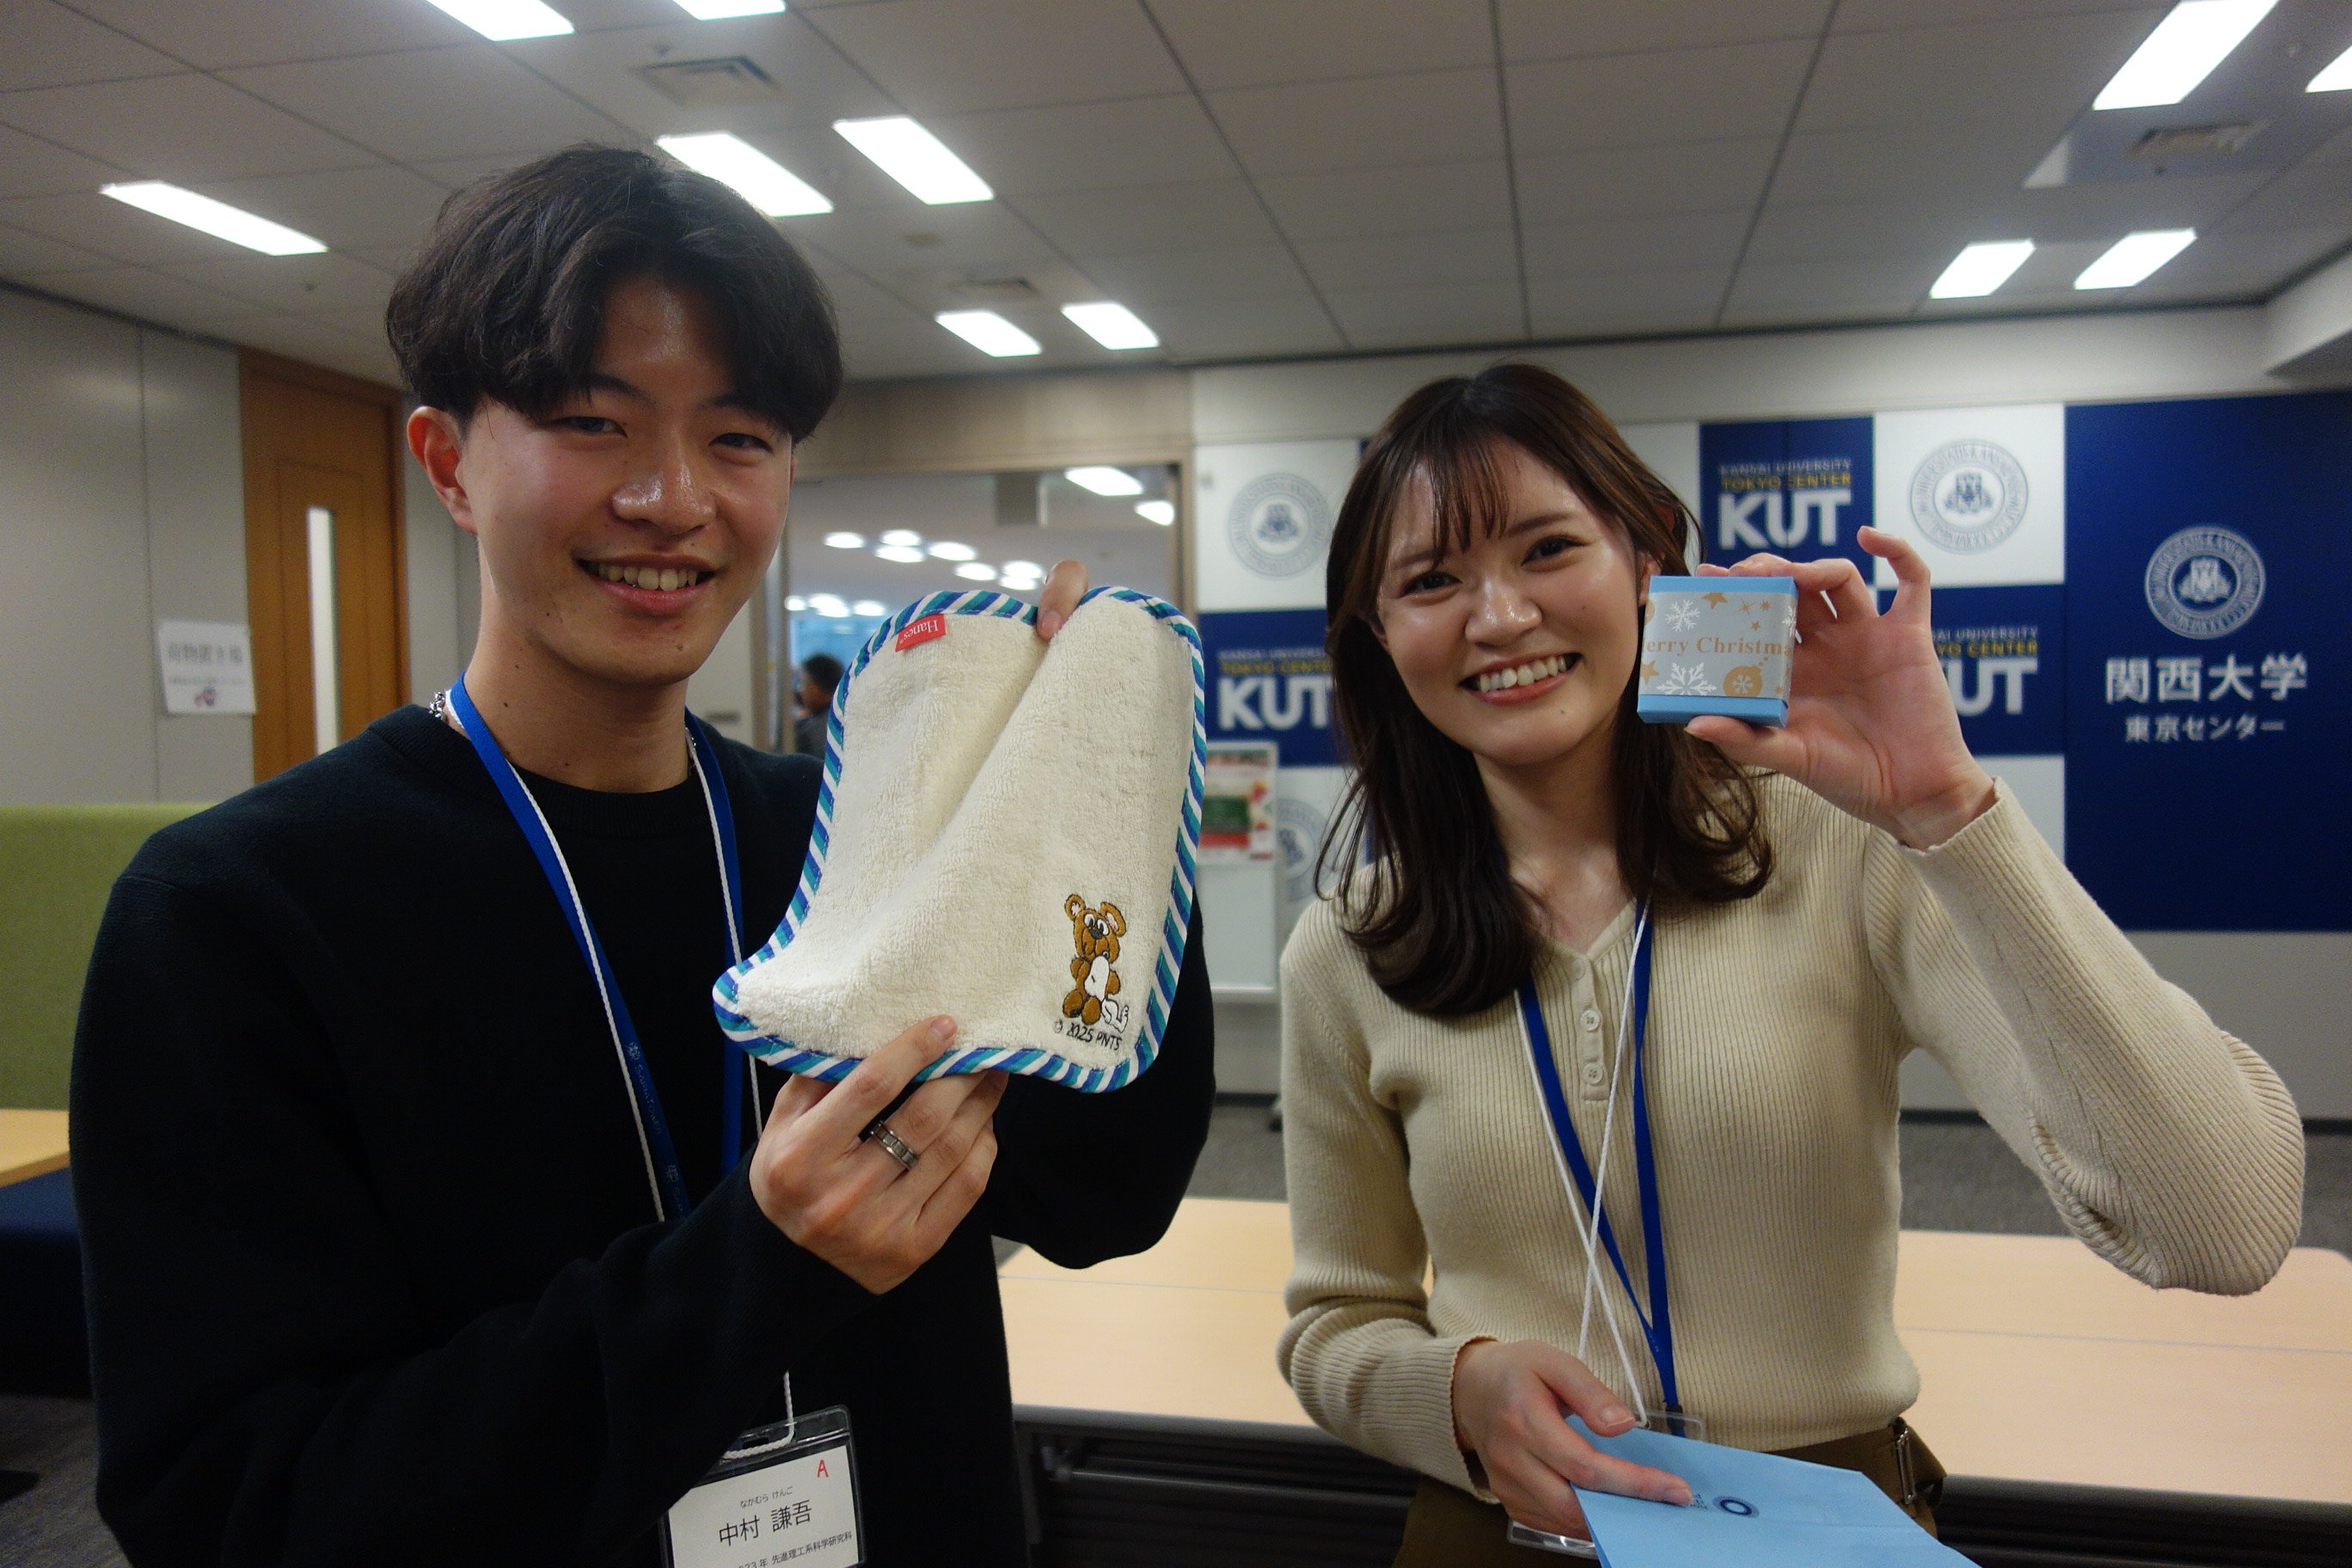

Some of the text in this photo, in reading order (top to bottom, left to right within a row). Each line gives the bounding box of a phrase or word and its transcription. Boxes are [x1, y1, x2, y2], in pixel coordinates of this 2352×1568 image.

[1719, 458, 1852, 475] KANSAI UNIVERSITY
[1722, 475, 1781, 491] TOKYO
[1718, 489, 1852, 550] KUT
[1956, 626, 2038, 640] UNIVERSITY
[1643, 636, 1794, 658] erry Christma
[1967, 640, 2038, 658] CENTER
[1277, 659, 1332, 674] CENTE
[2105, 653, 2307, 703] 関西大学
[1941, 657, 2038, 717] UT
[1217, 675, 1337, 729] KUT
[2125, 714, 2285, 743] 東京センター
[1066, 1022, 1094, 1043] 2025
[1095, 1032, 1123, 1050] PNTS
[817, 1459, 829, 1478] A
[740, 1485, 793, 1509] なかむら けんご
[719, 1499, 812, 1547] 中村 謙吾
